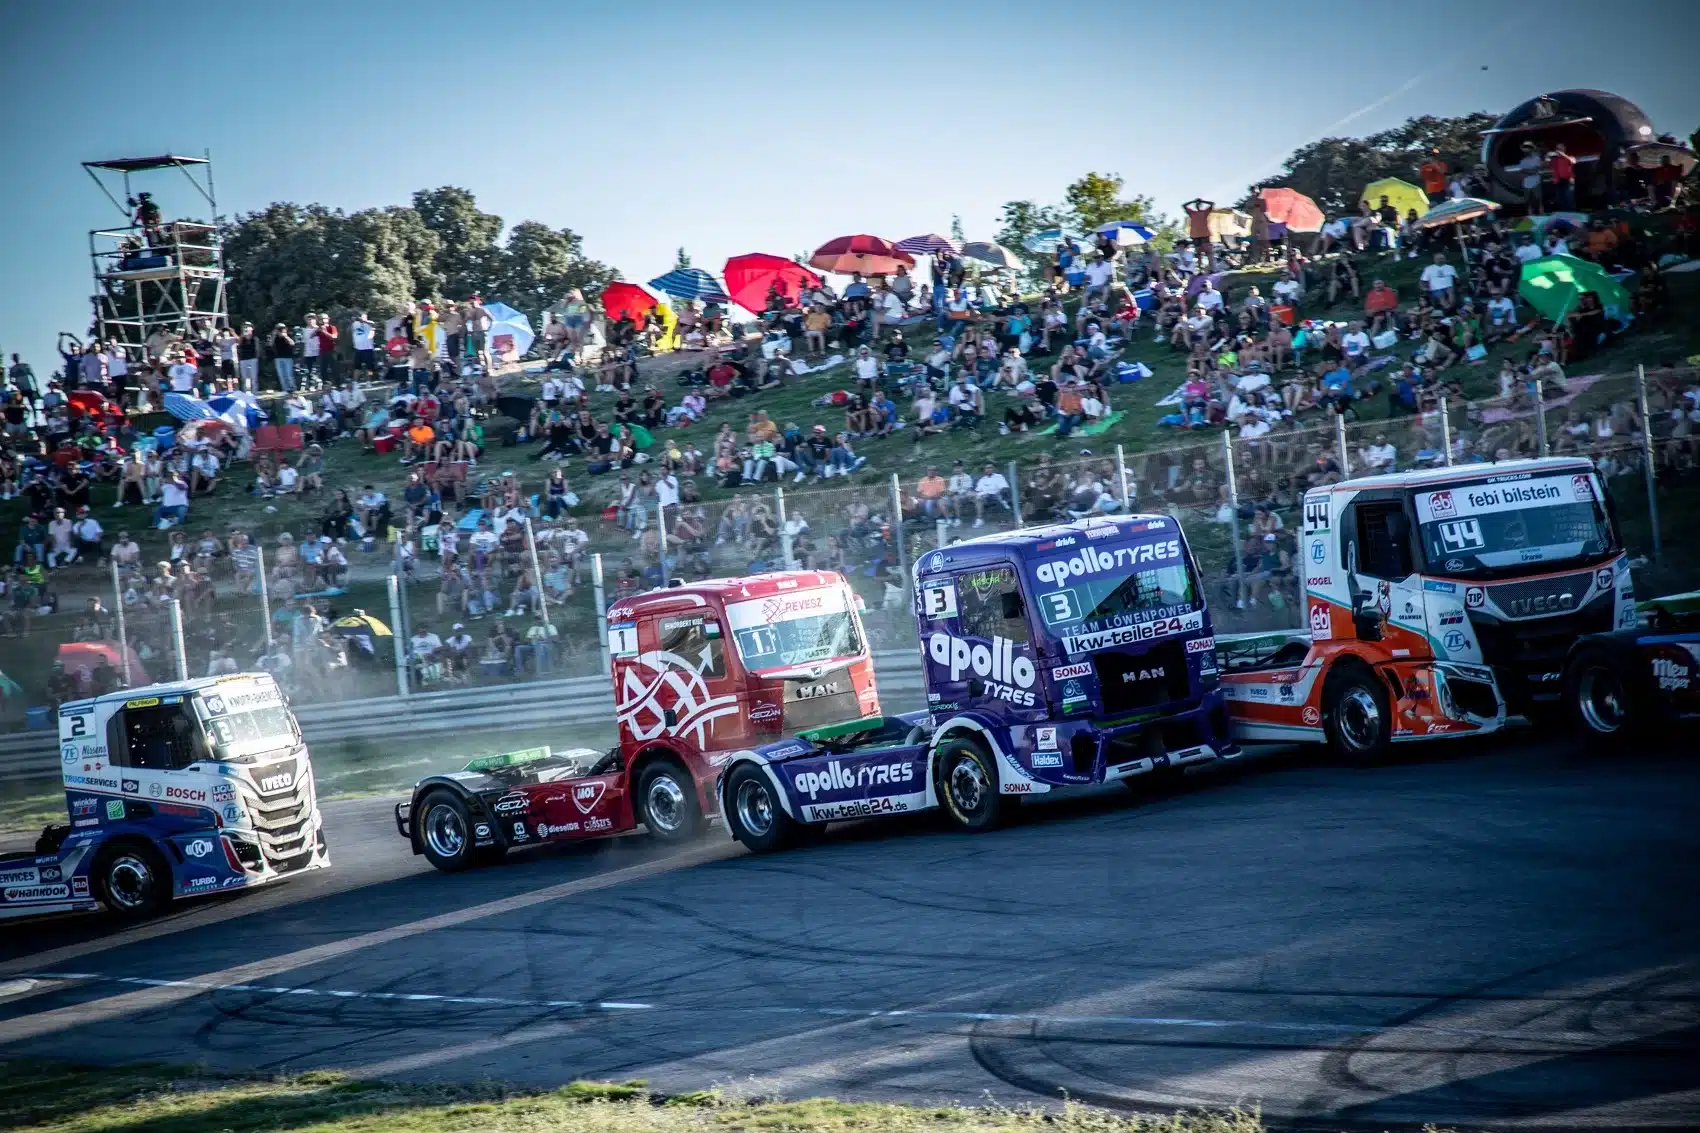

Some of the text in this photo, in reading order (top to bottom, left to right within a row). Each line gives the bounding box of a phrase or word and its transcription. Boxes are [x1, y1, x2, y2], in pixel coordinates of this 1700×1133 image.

[1469, 484, 1560, 508] febi bilstein
[1306, 504, 1329, 529] 44
[1441, 521, 1482, 548] 44
[933, 588, 947, 613] 3
[1052, 594, 1071, 620] 3
[1468, 593, 1482, 603] TIP
[1511, 593, 1573, 614] IVECO
[1063, 622, 1099, 637] TEAM
[1069, 618, 1200, 653] lkw-teile24.de
[619, 631, 626, 651] 1
[752, 632, 763, 653] 1
[1188, 638, 1214, 651] SONAX
[1448, 634, 1462, 647] ZF
[930, 633, 1035, 688] apollo
[1055, 664, 1091, 678] SONAX
[1122, 667, 1164, 683] MAN
[800, 682, 838, 698] MAN
[983, 680, 1035, 706] TYRES
[71, 716, 86, 736] 2
[217, 722, 233, 742] 2
[64, 748, 77, 760] ZF
[82, 744, 107, 756] Nissens
[1006, 754, 1035, 780] WABCO
[1034, 755, 1060, 766] Haldex
[261, 773, 292, 792] IVECO
[795, 761, 914, 800] apollo TYRES
[1004, 784, 1032, 792] SONAX
[166, 787, 206, 801] BOSCH
[213, 791, 237, 801] MOLY
[577, 786, 595, 799] MOL
[810, 797, 908, 822] lkw-teile24.de
[191, 876, 217, 887] TURBO
